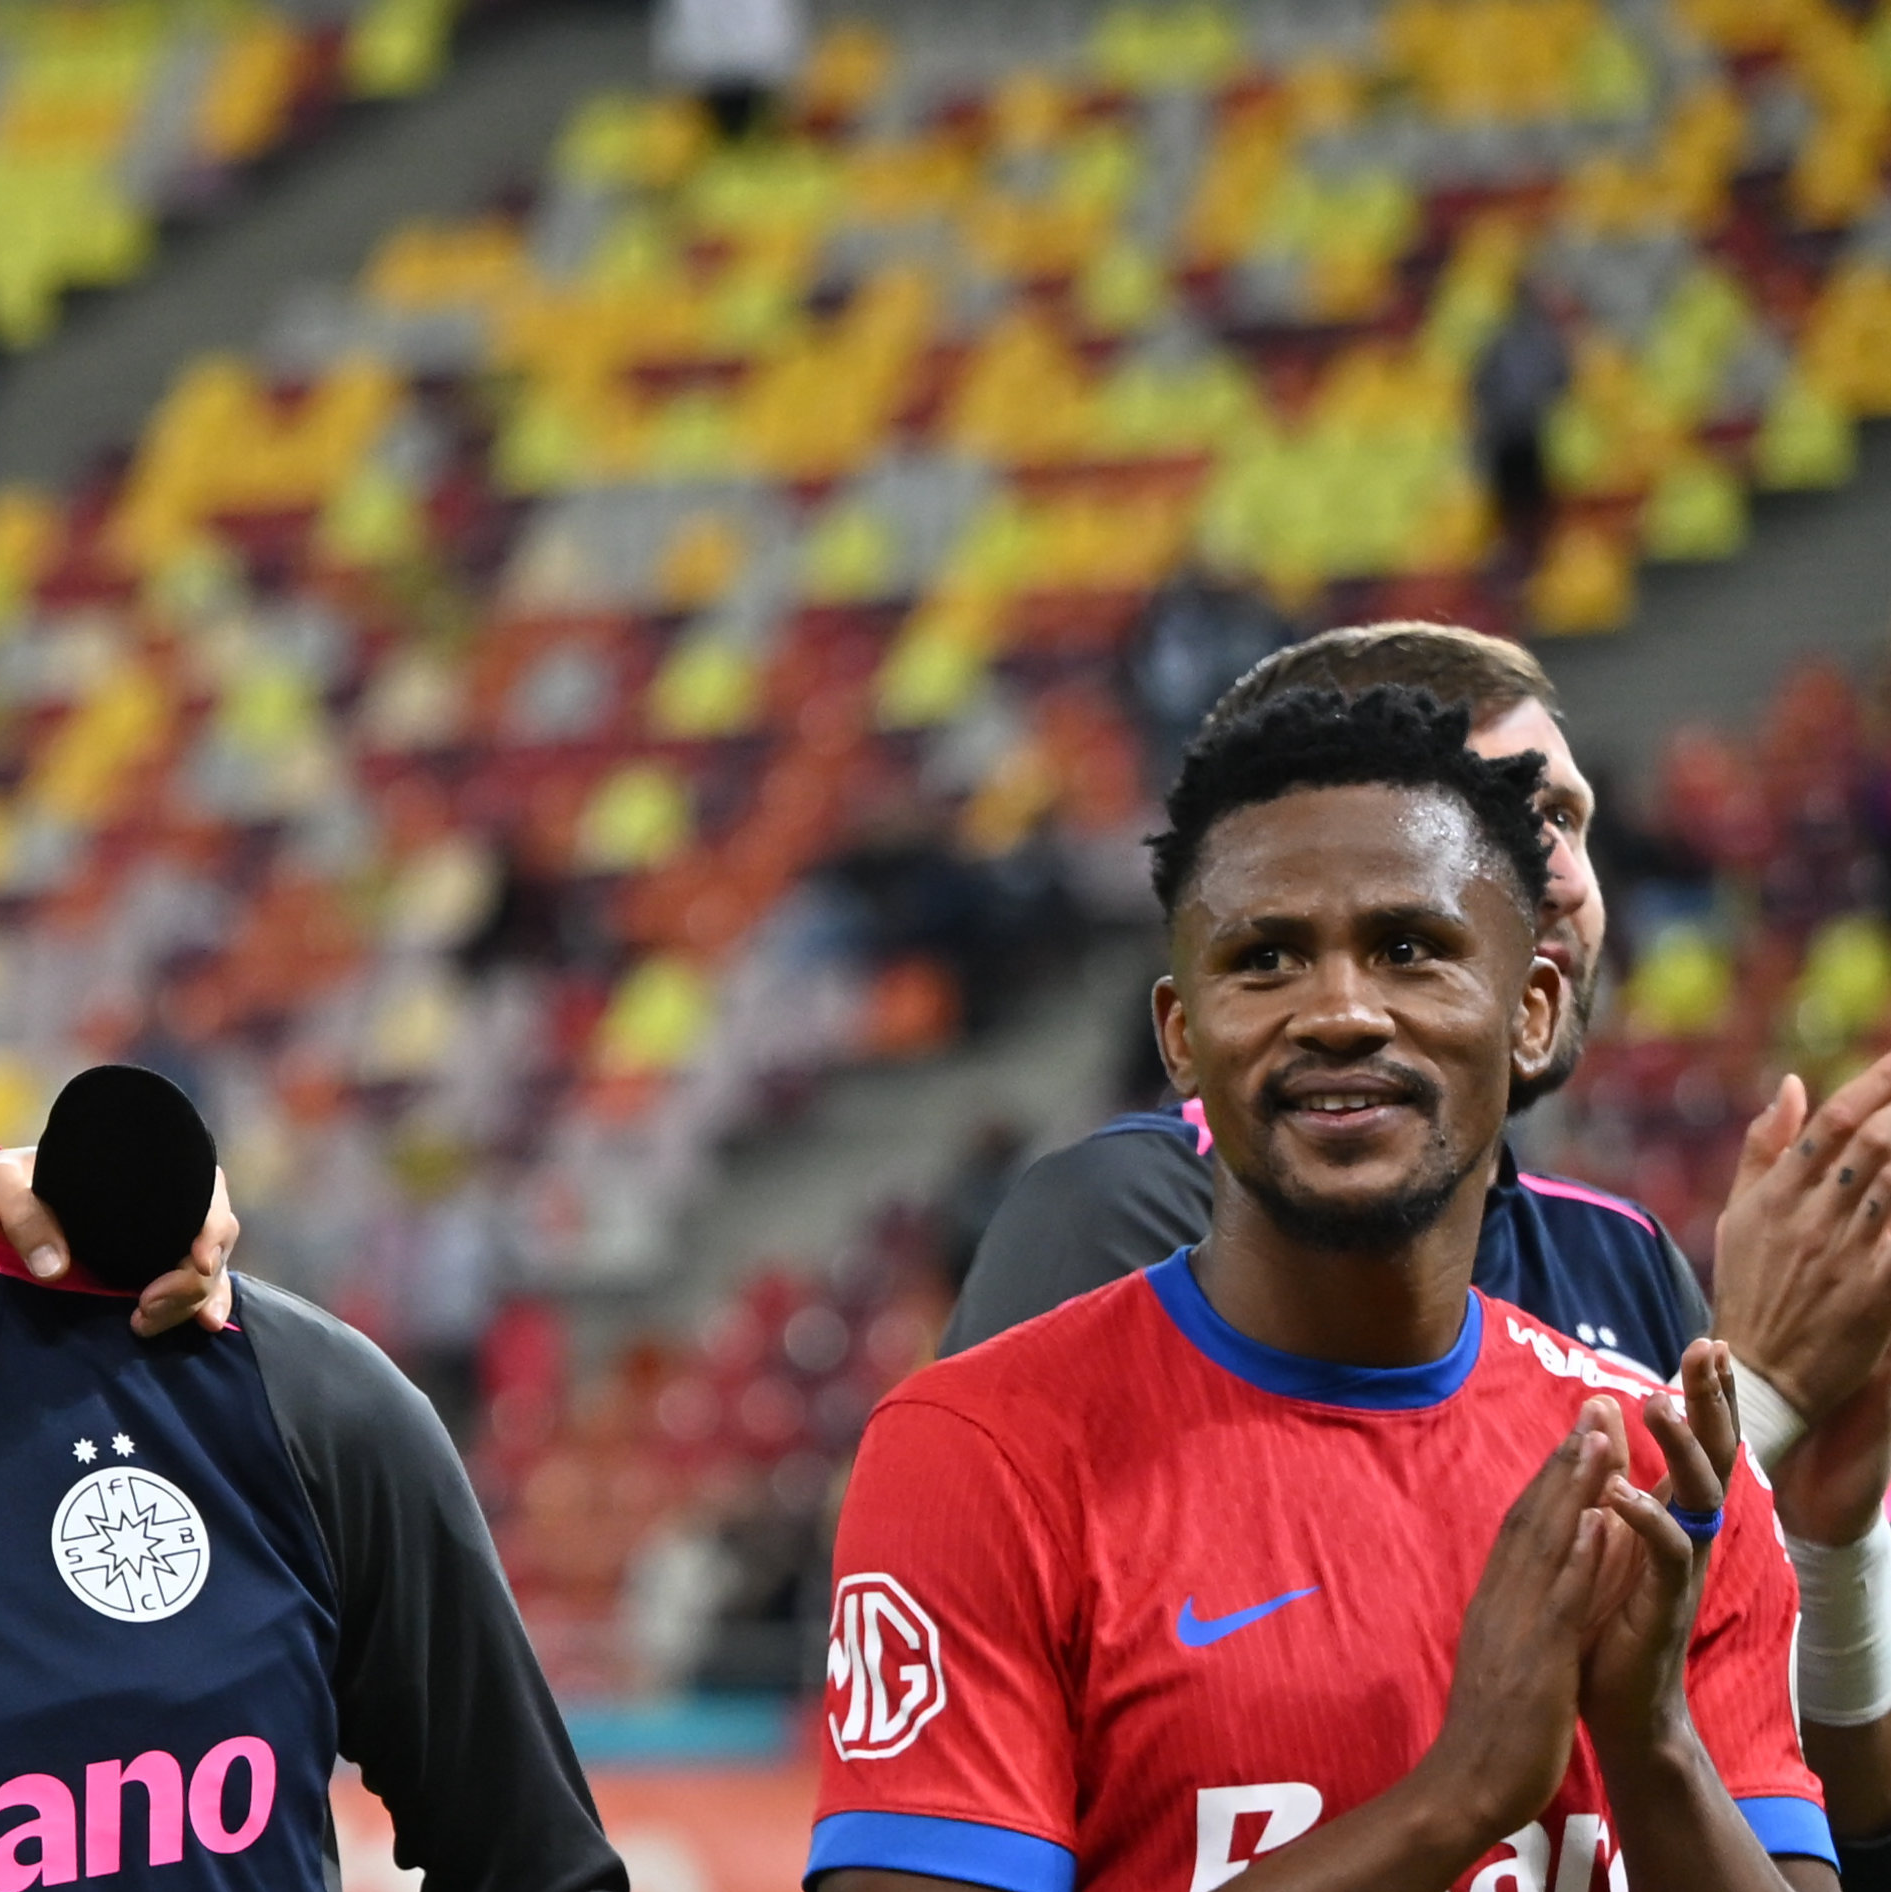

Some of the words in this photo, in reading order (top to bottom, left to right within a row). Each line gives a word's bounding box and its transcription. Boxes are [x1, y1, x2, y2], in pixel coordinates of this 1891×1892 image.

[178, 1526, 195, 1545] B
[64, 1547, 83, 1565] S
[141, 1593, 157, 1611] C
